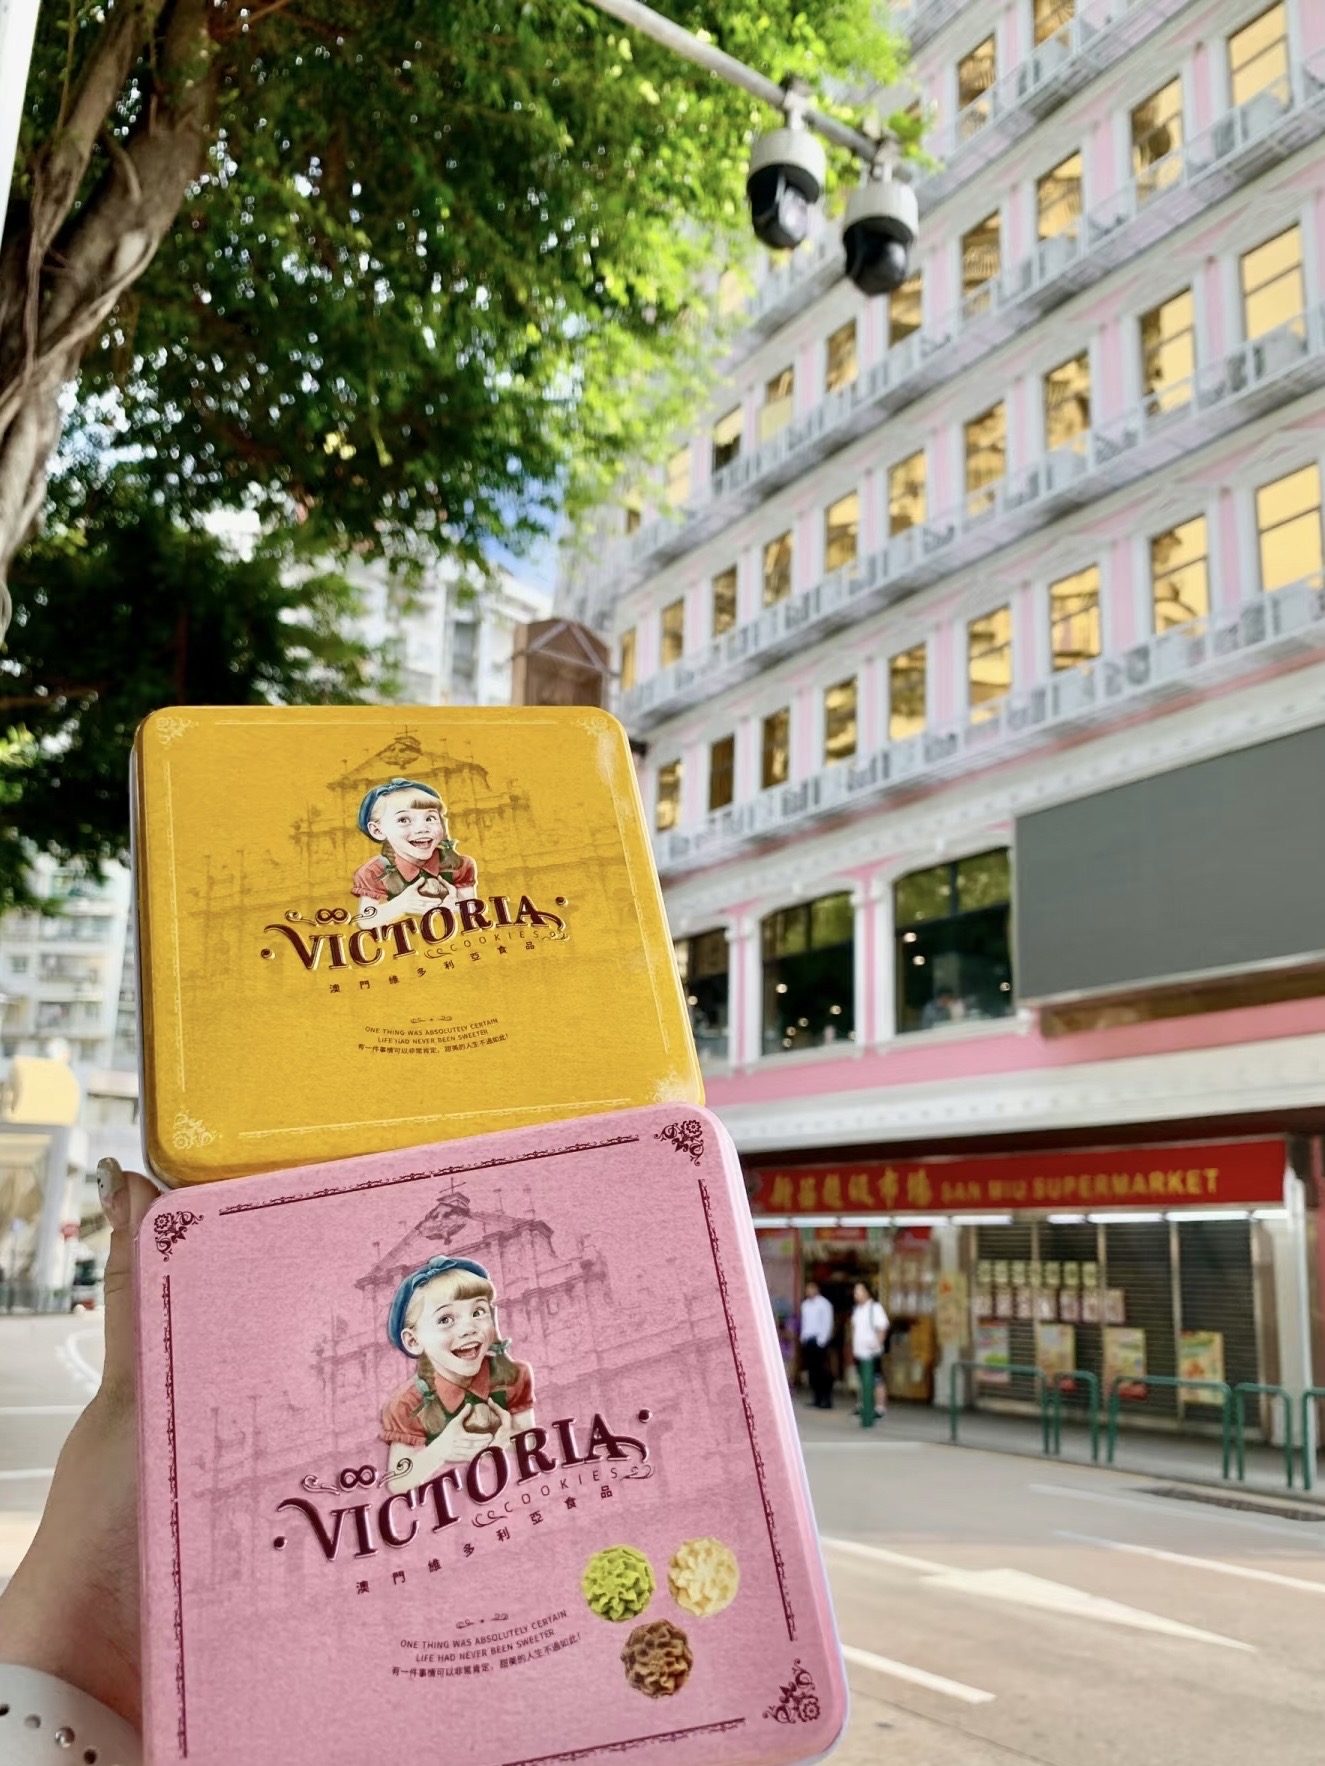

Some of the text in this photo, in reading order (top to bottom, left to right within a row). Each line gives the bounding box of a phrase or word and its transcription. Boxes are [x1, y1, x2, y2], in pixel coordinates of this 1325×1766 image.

[264, 895, 566, 971] VICTORIA
[450, 931, 540, 952] COOKIES
[329, 941, 535, 994] 澳門維多利亞食品
[383, 1028, 405, 1036] THING
[425, 1025, 468, 1036] ABSOLUTELY
[470, 1018, 498, 1030] CERTAIN
[438, 1035, 456, 1043] BEEN
[458, 1029, 488, 1041] SWEETER
[1033, 1167, 1219, 1201] SUPERMARKET
[277, 1413, 649, 1562] VICTORIA
[503, 1466, 619, 1513] COOKIES
[356, 1485, 613, 1594] 澳門維多利亞食品
[400, 1610, 568, 1649] ONE THING WAS ABSOLUTELY CERTAIN
[415, 1629, 555, 1662] LIFE HAD NEVER BEEN SWEETER
